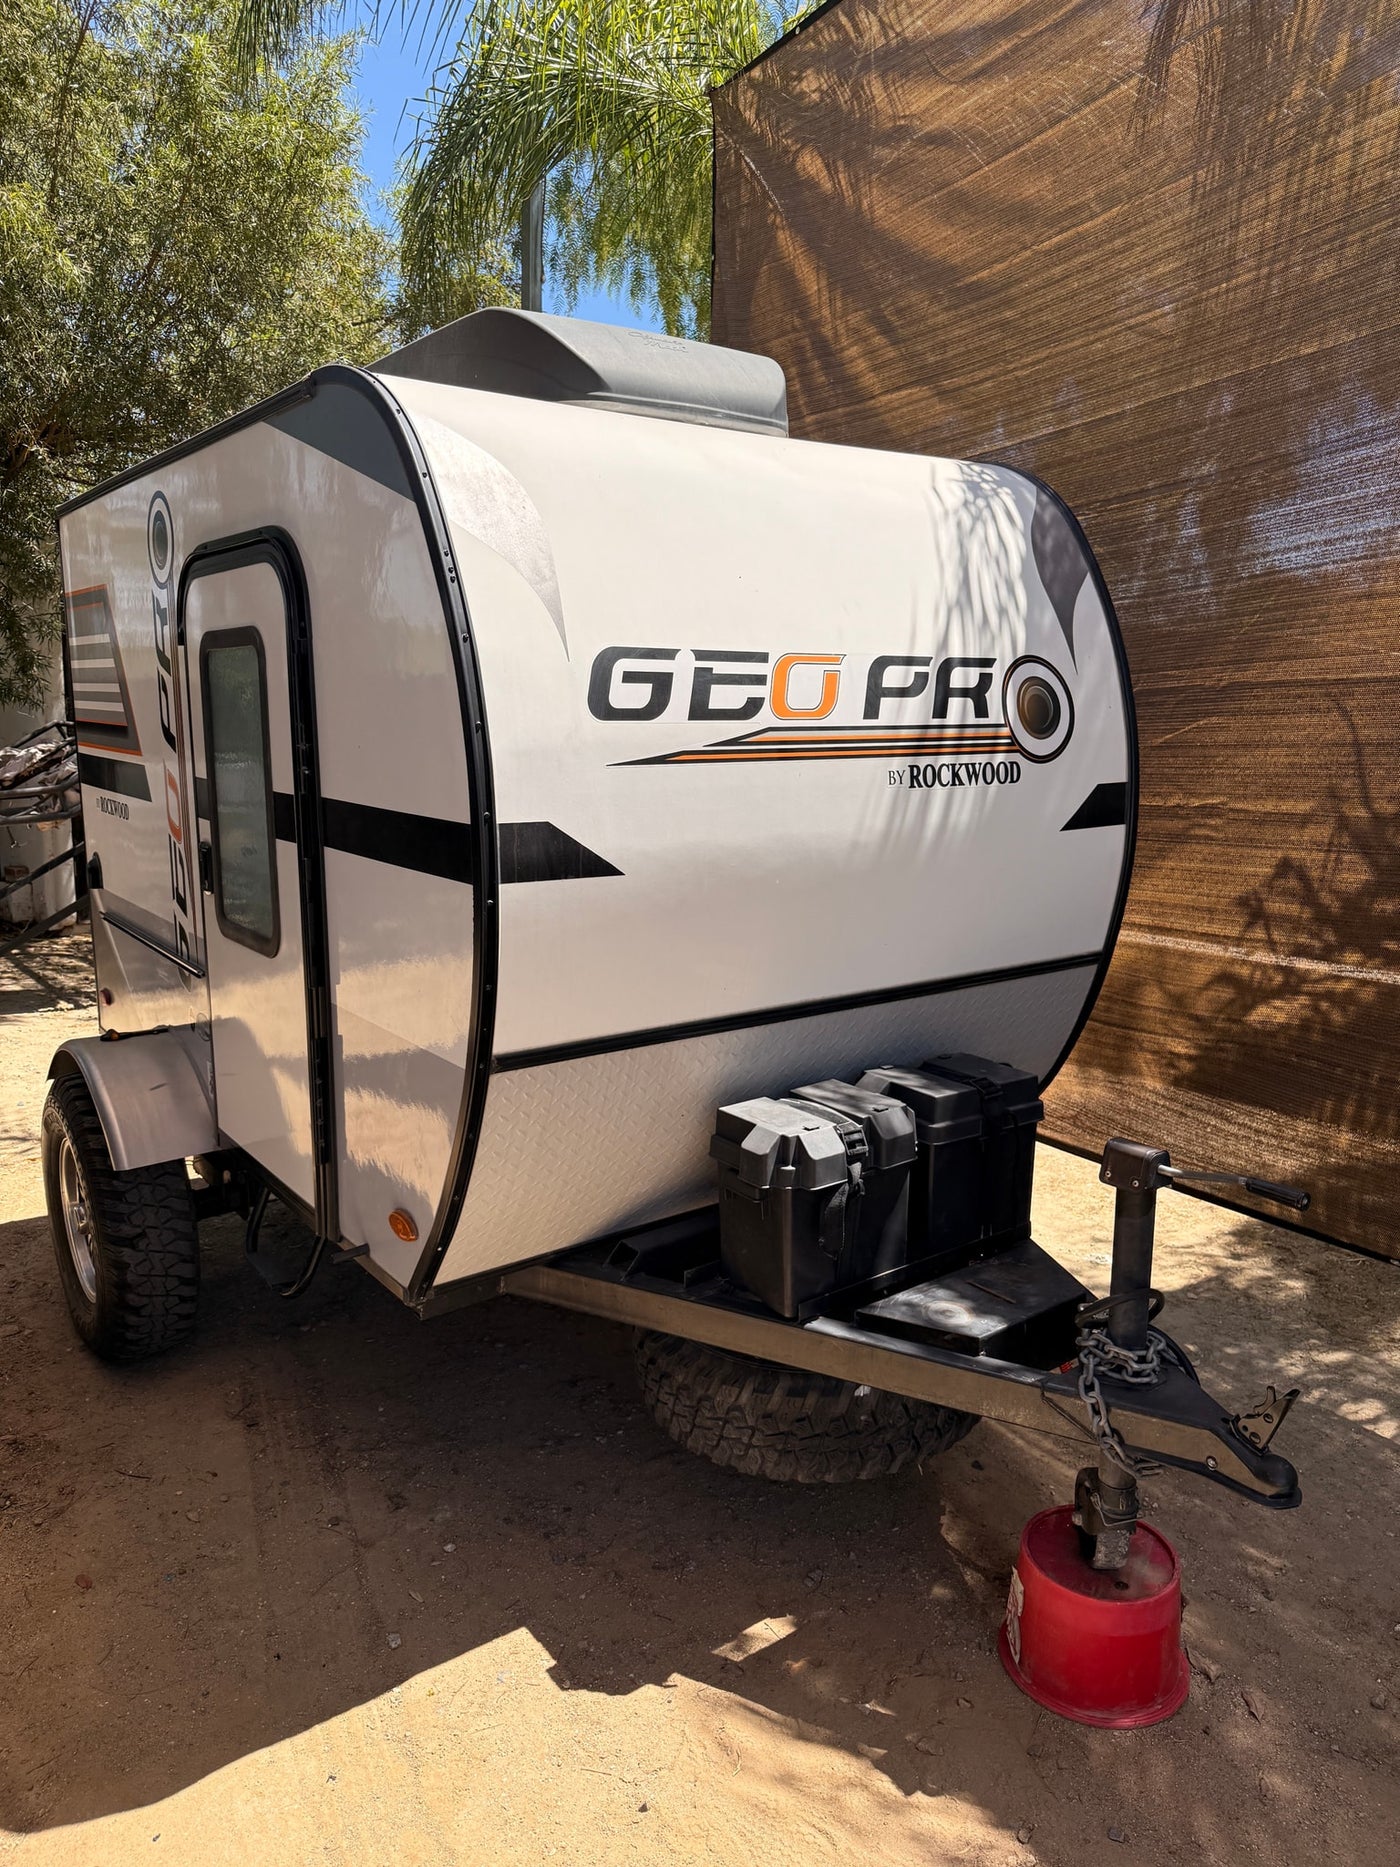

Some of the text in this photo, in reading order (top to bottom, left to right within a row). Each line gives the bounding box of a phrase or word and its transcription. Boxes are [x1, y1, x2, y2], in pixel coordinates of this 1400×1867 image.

[587, 646, 1075, 764] GEO PRO
[888, 761, 1021, 788] BY ROCKWOOD
[100, 796, 129, 820] ROCKWOOD
